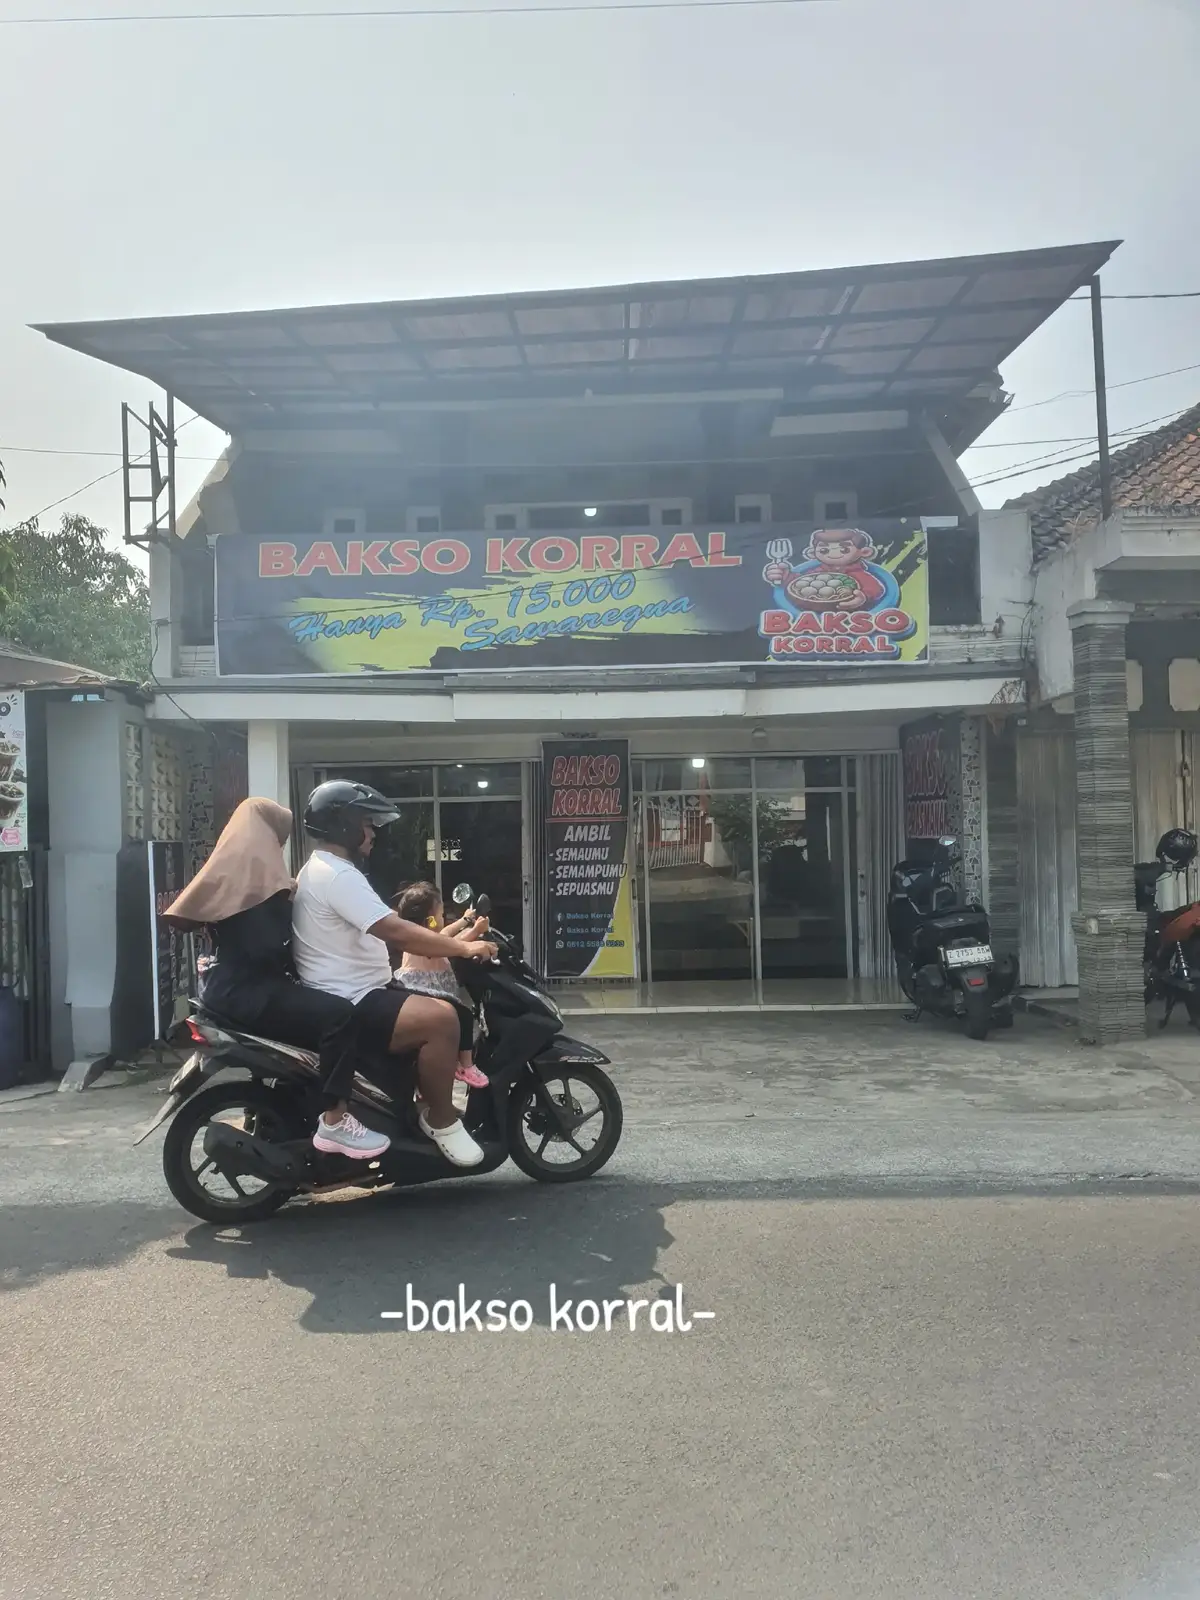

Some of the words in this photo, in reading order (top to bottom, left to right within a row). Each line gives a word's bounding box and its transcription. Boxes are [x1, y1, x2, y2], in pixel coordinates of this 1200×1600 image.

[259, 538, 472, 577] BAKSO
[485, 532, 743, 574] KORRAL
[288, 612, 407, 643] Hanya
[418, 595, 485, 628] Rp.
[507, 570, 636, 618] 15.000
[460, 596, 696, 651] Sawaregna
[760, 608, 912, 635] BAKSO
[770, 635, 898, 654] KORRAL
[550, 754, 621, 787] BAKSO
[551, 787, 623, 816] KORRAL
[563, 824, 612, 842] AMBIL
[566, 912, 589, 920] Bakso
[566, 926, 589, 934] Bakso
